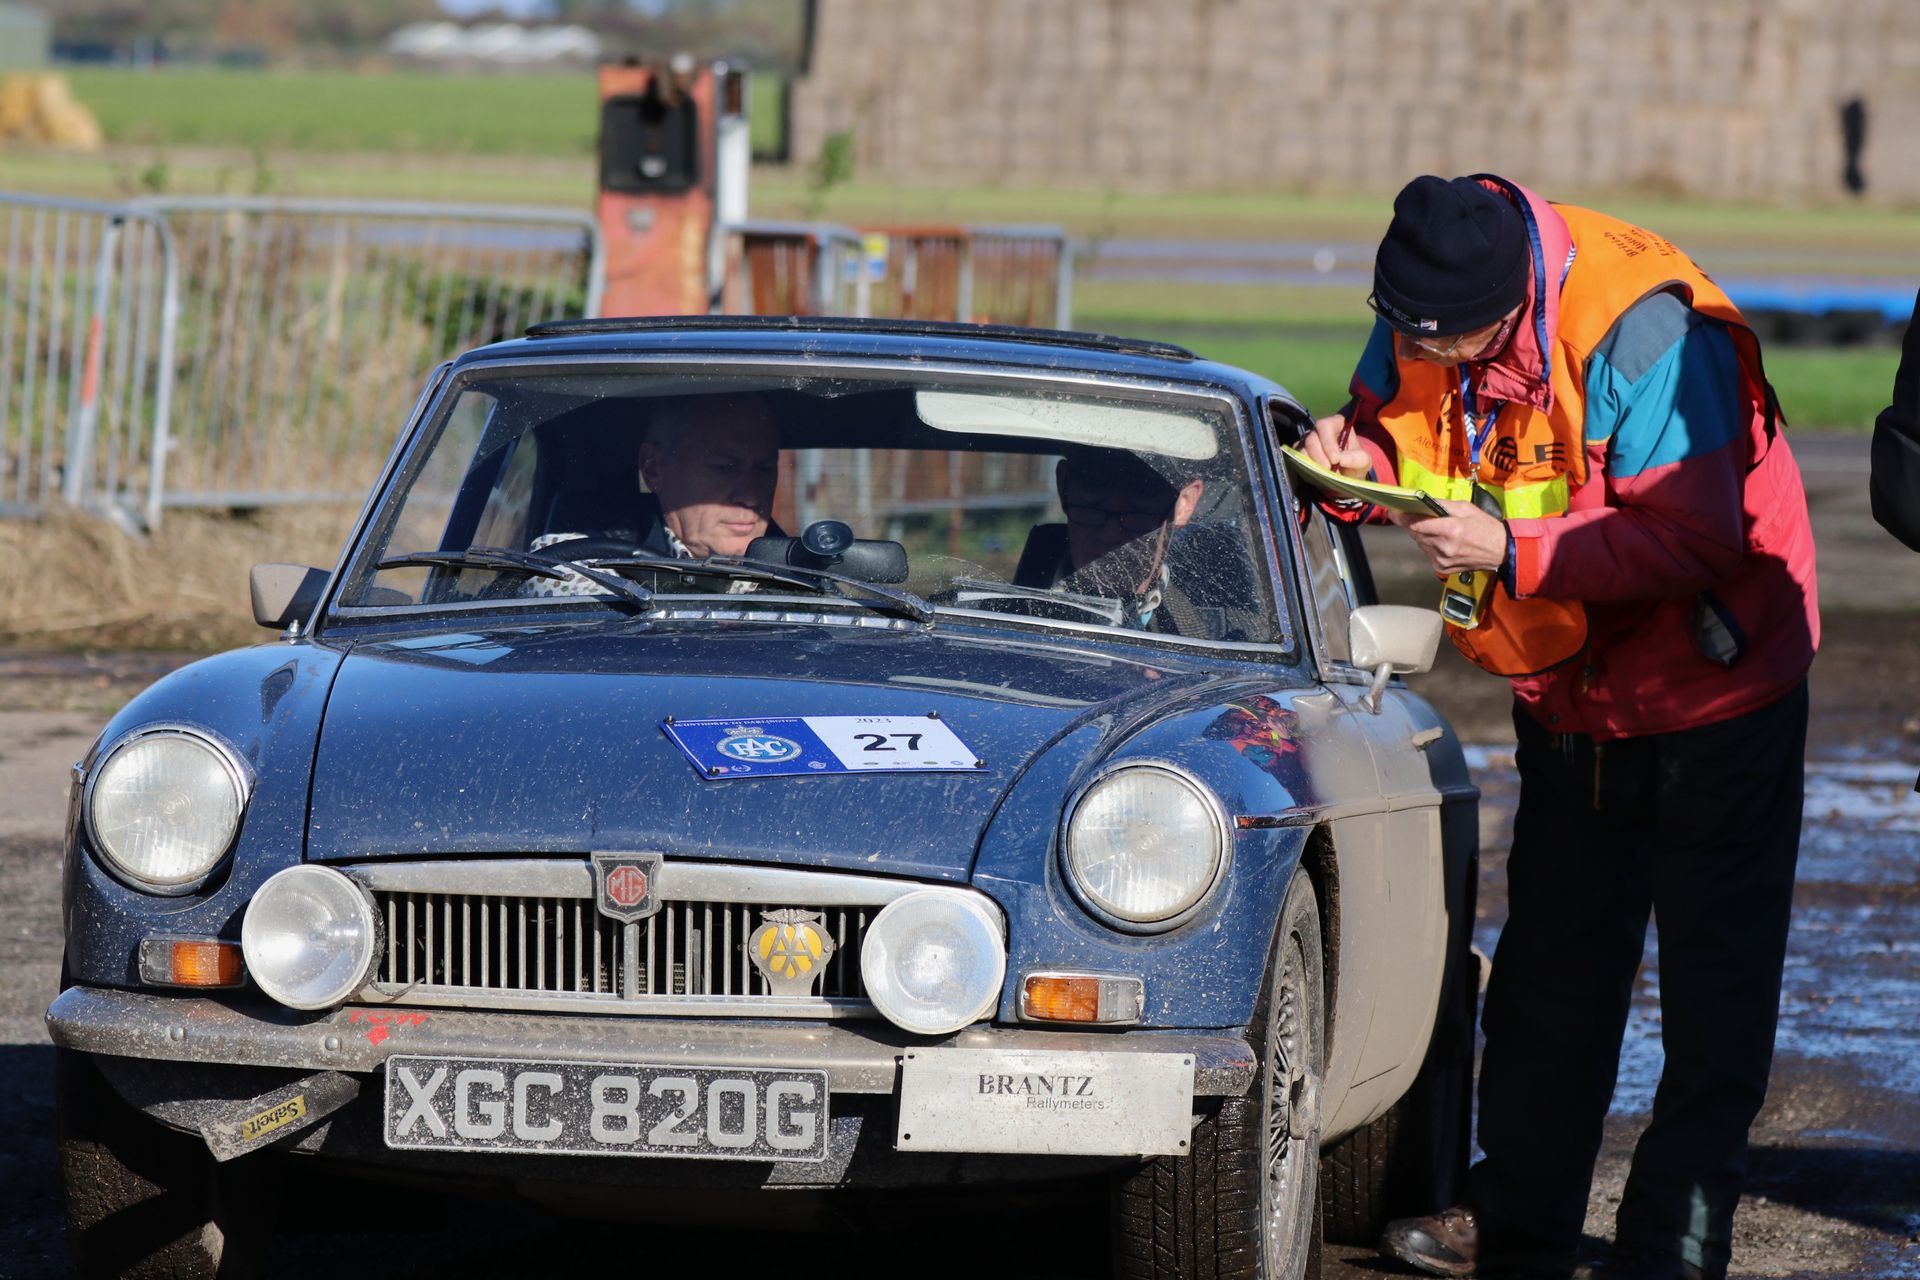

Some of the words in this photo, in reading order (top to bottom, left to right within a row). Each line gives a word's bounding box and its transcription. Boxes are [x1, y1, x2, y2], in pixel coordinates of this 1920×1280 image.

[1603, 231, 1640, 258] British
[729, 737, 788, 757] RAC
[853, 733, 924, 751] 27
[611, 870, 644, 899] MG
[978, 1074, 1095, 1096] BRANTZ
[397, 1066, 564, 1142] XGC
[589, 1075, 818, 1150] 820G
[1026, 1097, 1105, 1111] Rallymeters
[249, 1101, 299, 1135] Sabelt
